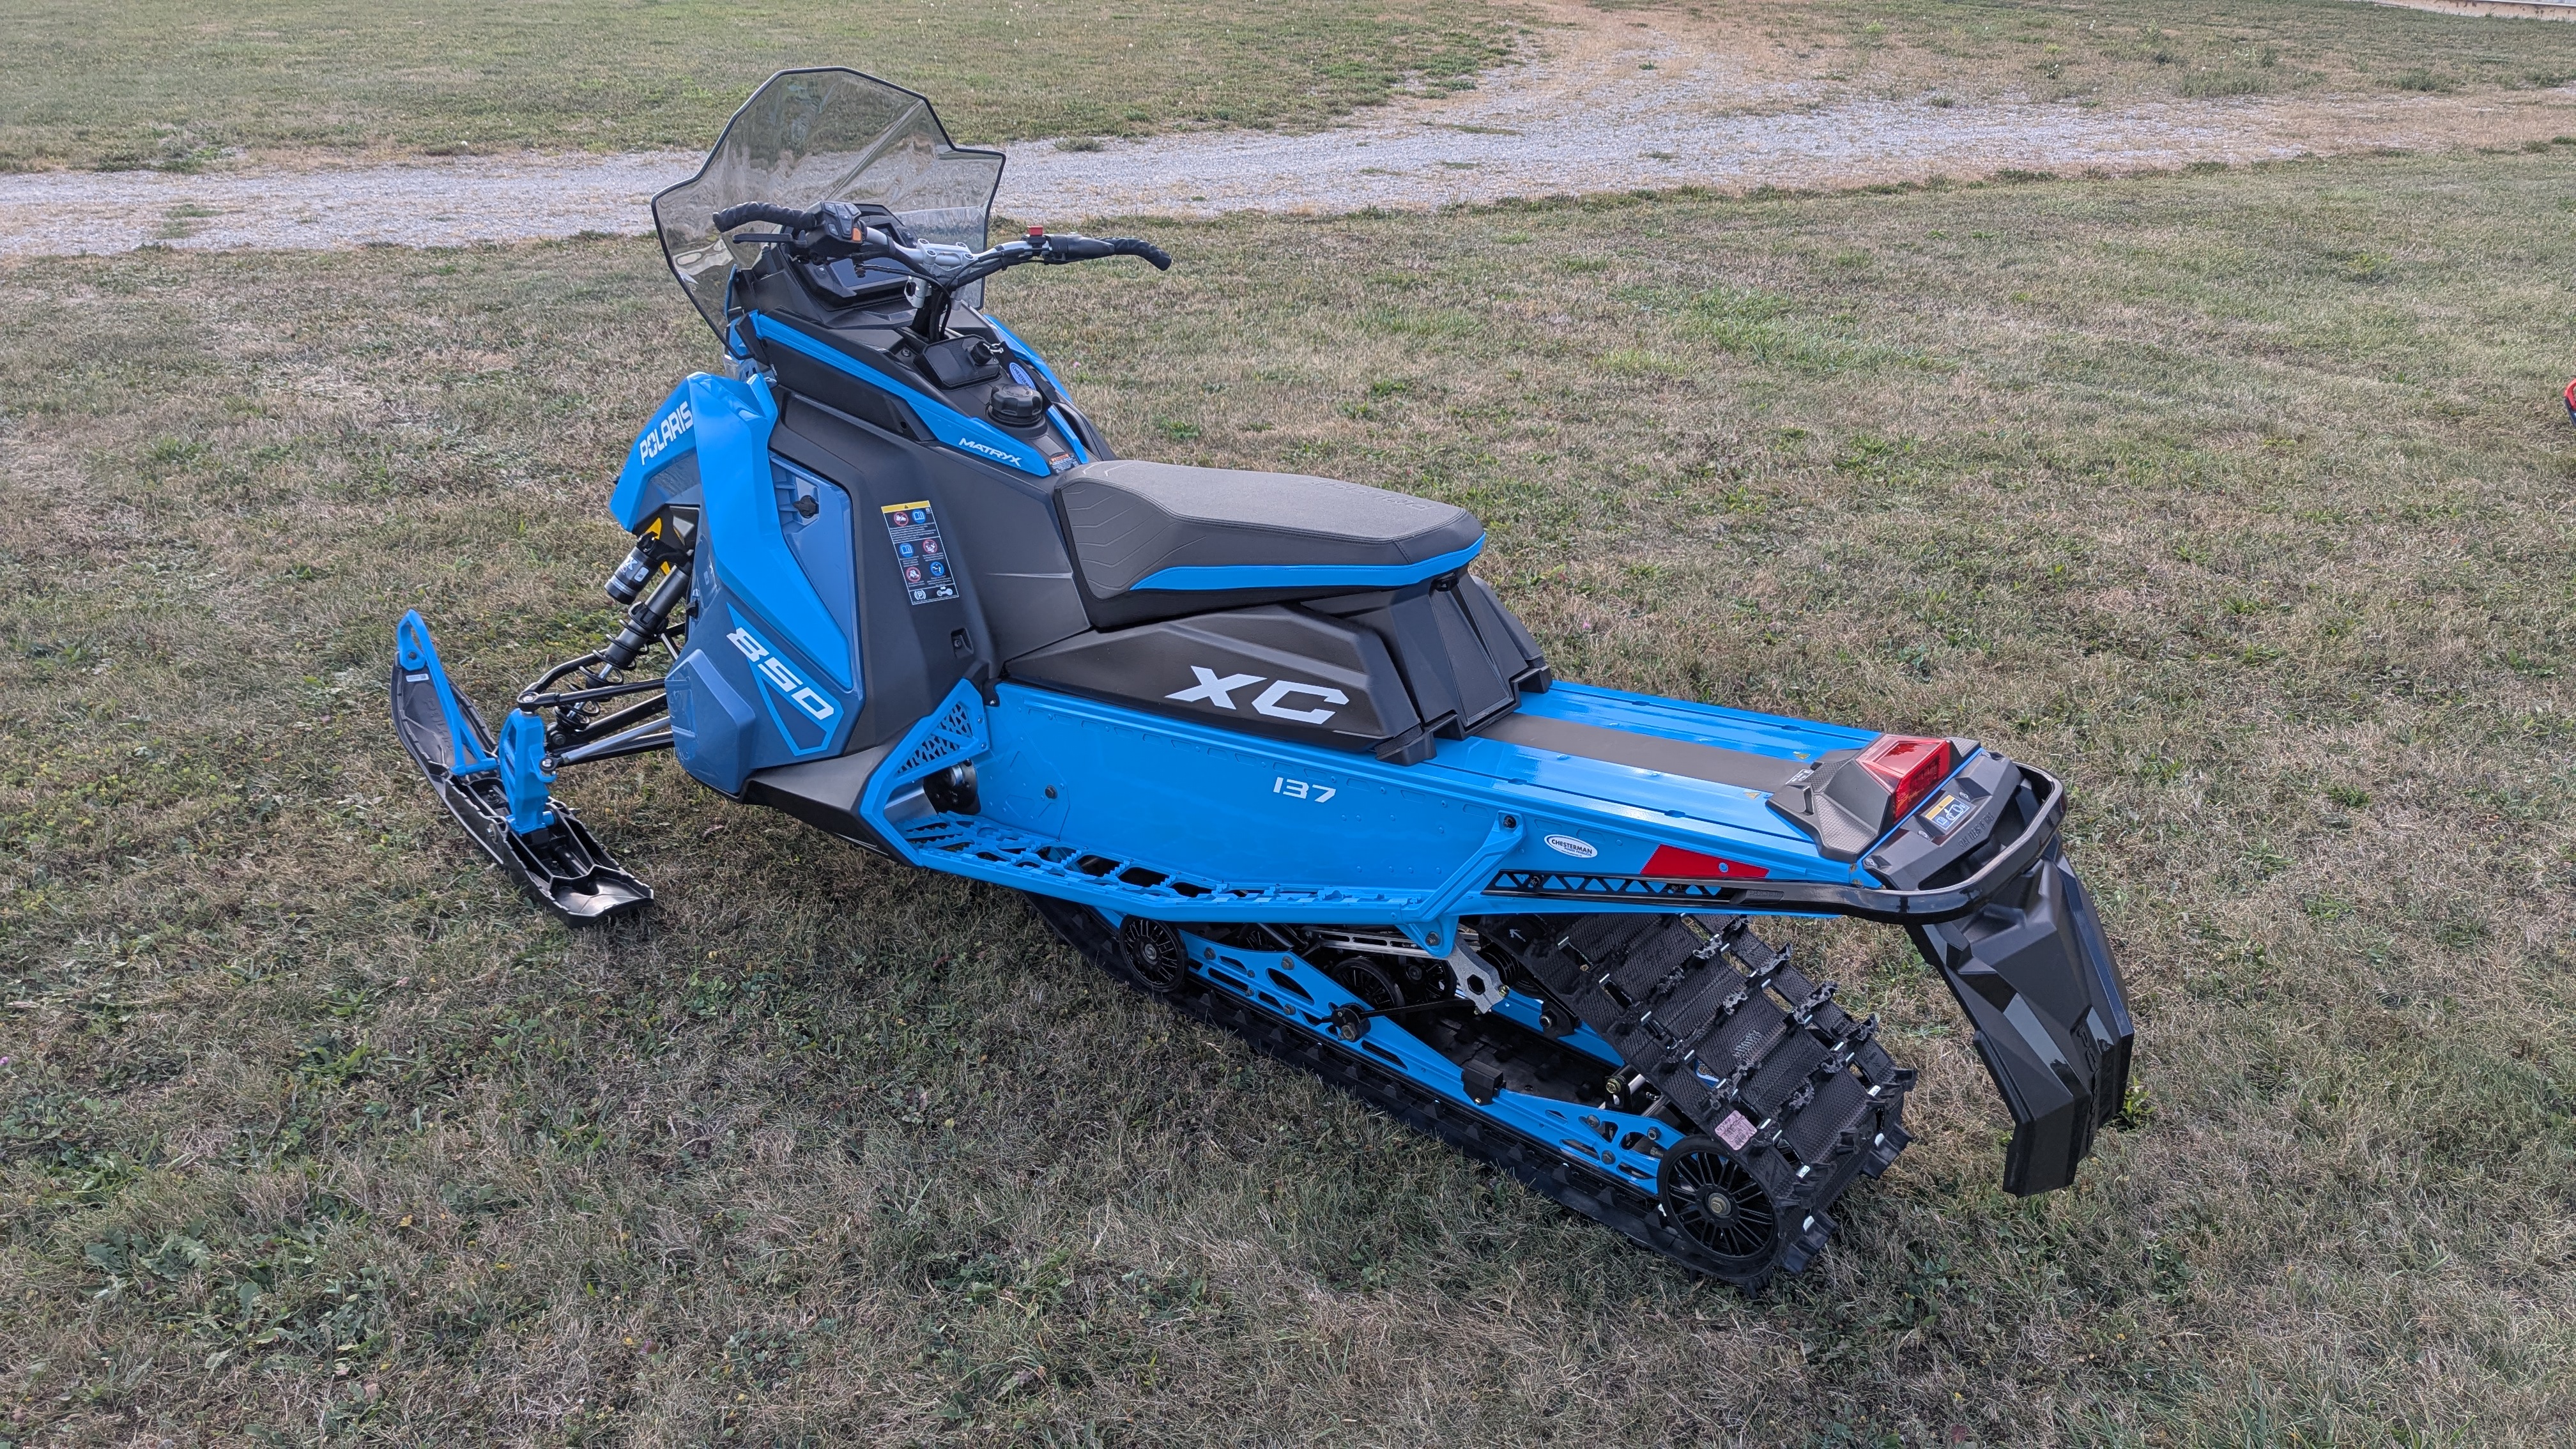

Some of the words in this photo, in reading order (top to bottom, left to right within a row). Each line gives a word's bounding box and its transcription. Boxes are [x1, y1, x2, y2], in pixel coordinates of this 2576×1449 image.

[640, 401, 693, 466] POLARIS
[959, 438, 1022, 467] MATRYX
[726, 627, 834, 720] 850
[1164, 665, 1350, 724] XC
[1273, 776, 1337, 803] 137
[1551, 839, 1593, 854] CHESTERMAN
